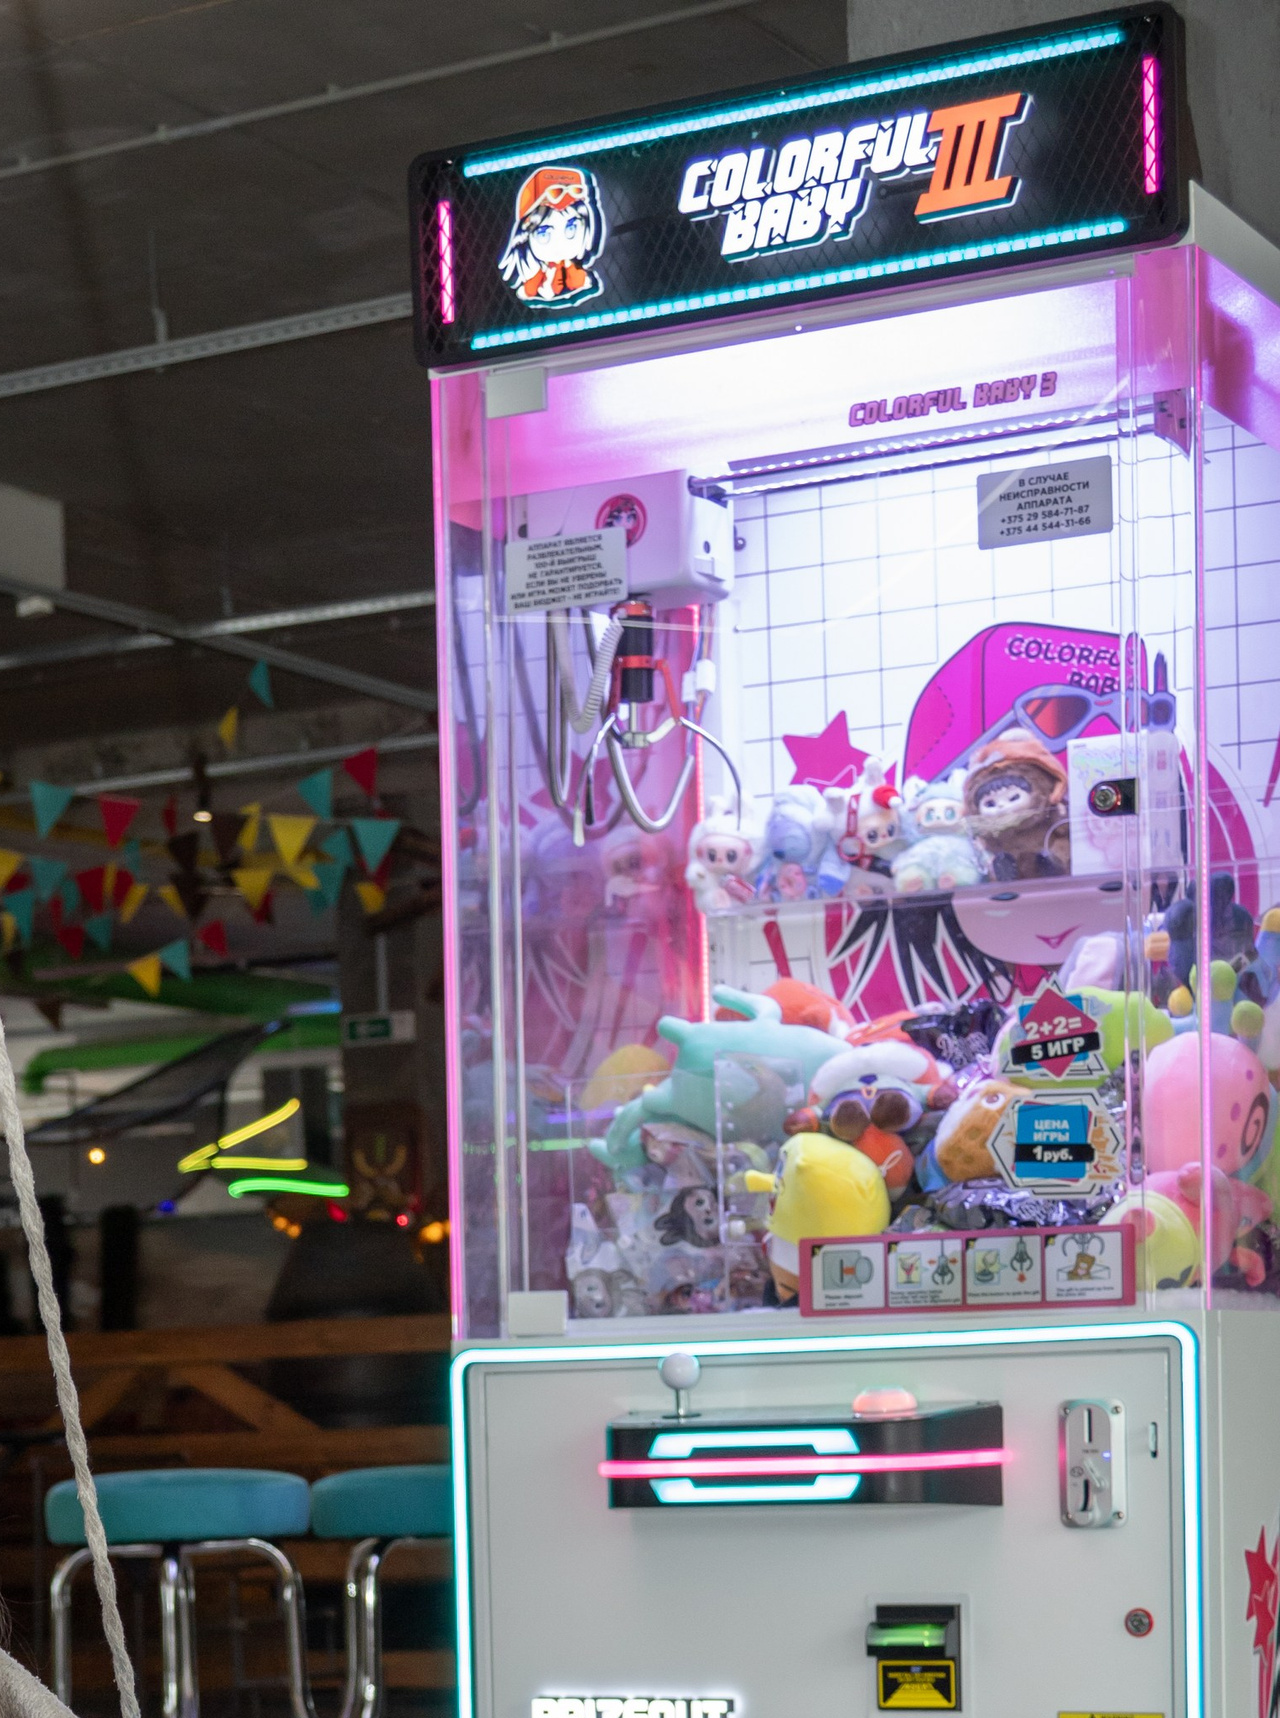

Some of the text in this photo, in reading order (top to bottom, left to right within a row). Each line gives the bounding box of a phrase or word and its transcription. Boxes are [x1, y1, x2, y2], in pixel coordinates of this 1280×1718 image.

[677, 92, 1024, 216] COLORFUL III
[721, 177, 864, 256] BABY
[848, 371, 1058, 427] COLORFUL BABY 3
[1018, 472, 1070, 487] В СЛУЧАЕ
[999, 481, 1090, 502] НЕИСПРАВНОСТИ
[1016, 495, 1073, 511] АППАРАТА
[1001, 504, 1090, 525] +375 29 584-71-87
[1000, 526, 1023, 537] +375
[1025, 524, 1038, 533] 44
[1007, 637, 1131, 668] COLORFU
[1070, 671, 1121, 696] BAB
[1025, 1016, 1083, 1041] 2+2=
[1031, 1037, 1085, 1060] 5 ИГР
[1034, 1119, 1069, 1131] ЦЕНА
[1033, 1132, 1069, 1142] ИГРЫ
